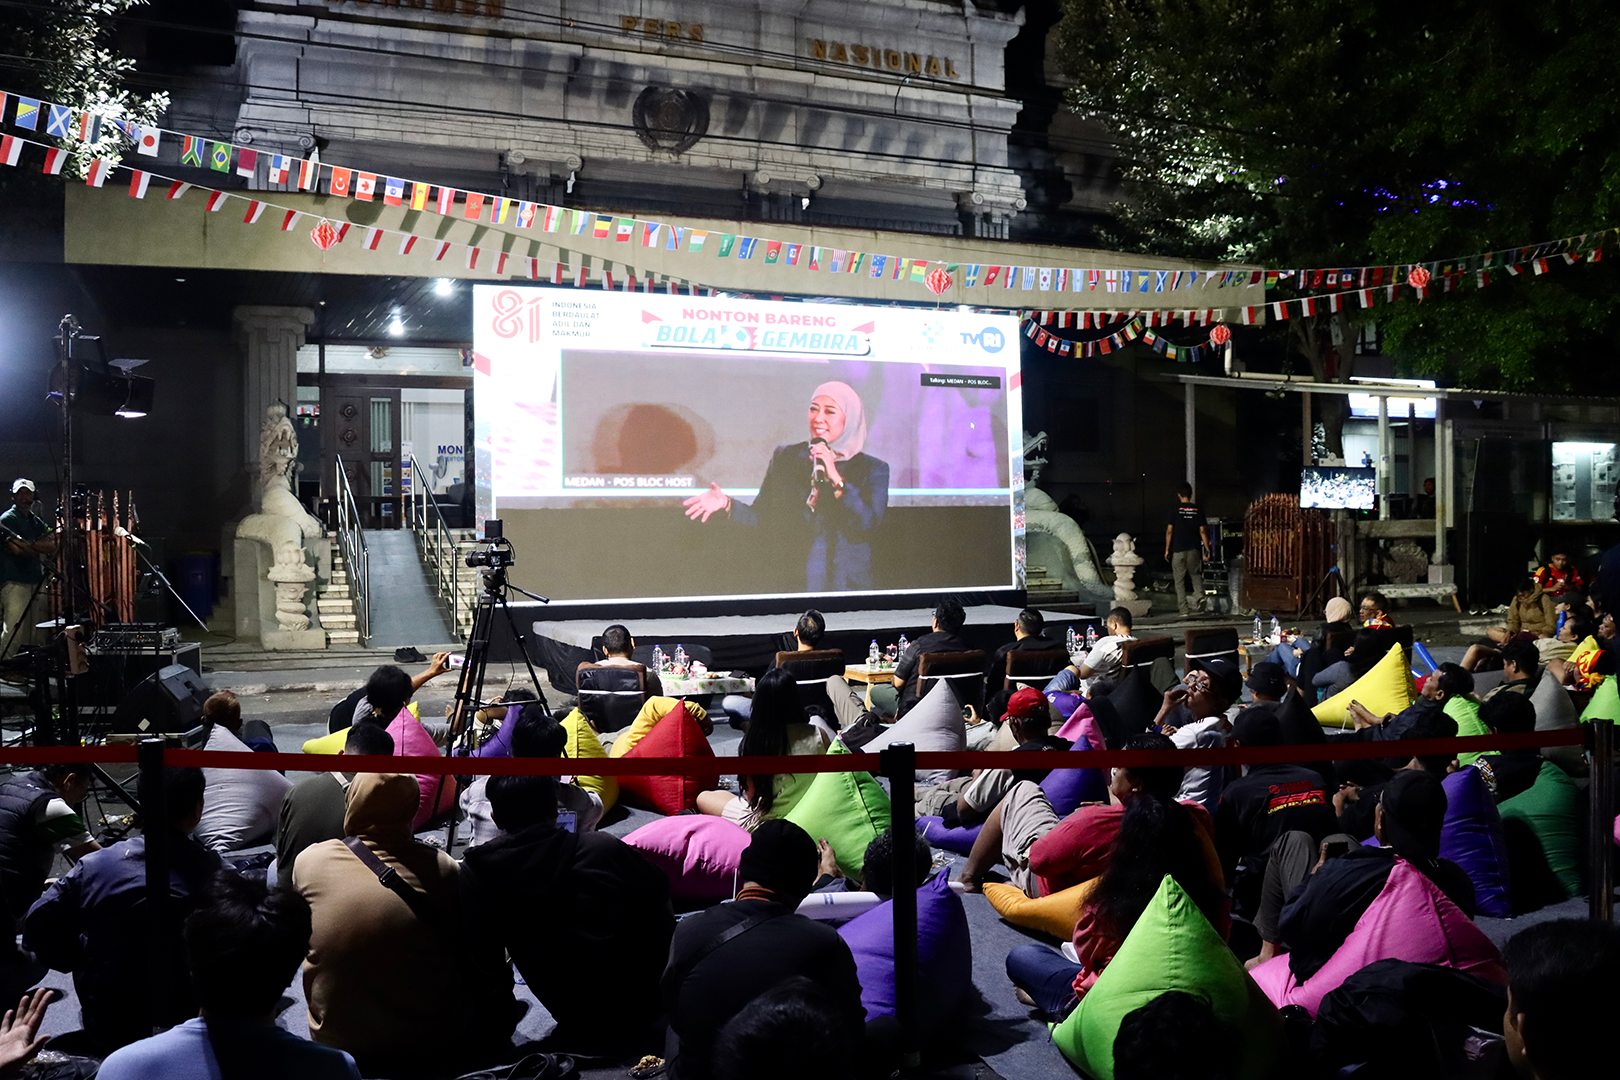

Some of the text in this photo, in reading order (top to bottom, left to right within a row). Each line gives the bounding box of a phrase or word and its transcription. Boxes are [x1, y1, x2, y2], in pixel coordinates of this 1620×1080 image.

[621, 15, 704, 43] PERS
[810, 39, 960, 78] NASIONAL
[492, 290, 544, 343] 81
[552, 311, 599, 319] BERDAULAT
[682, 309, 836, 327] NONTON BARENG
[656, 325, 858, 350] BOLA GEMBIRA
[564, 477, 605, 487] MEDAN
[613, 477, 635, 487] POS
[637, 477, 663, 487] BLOC
[665, 477, 693, 487] HOST
